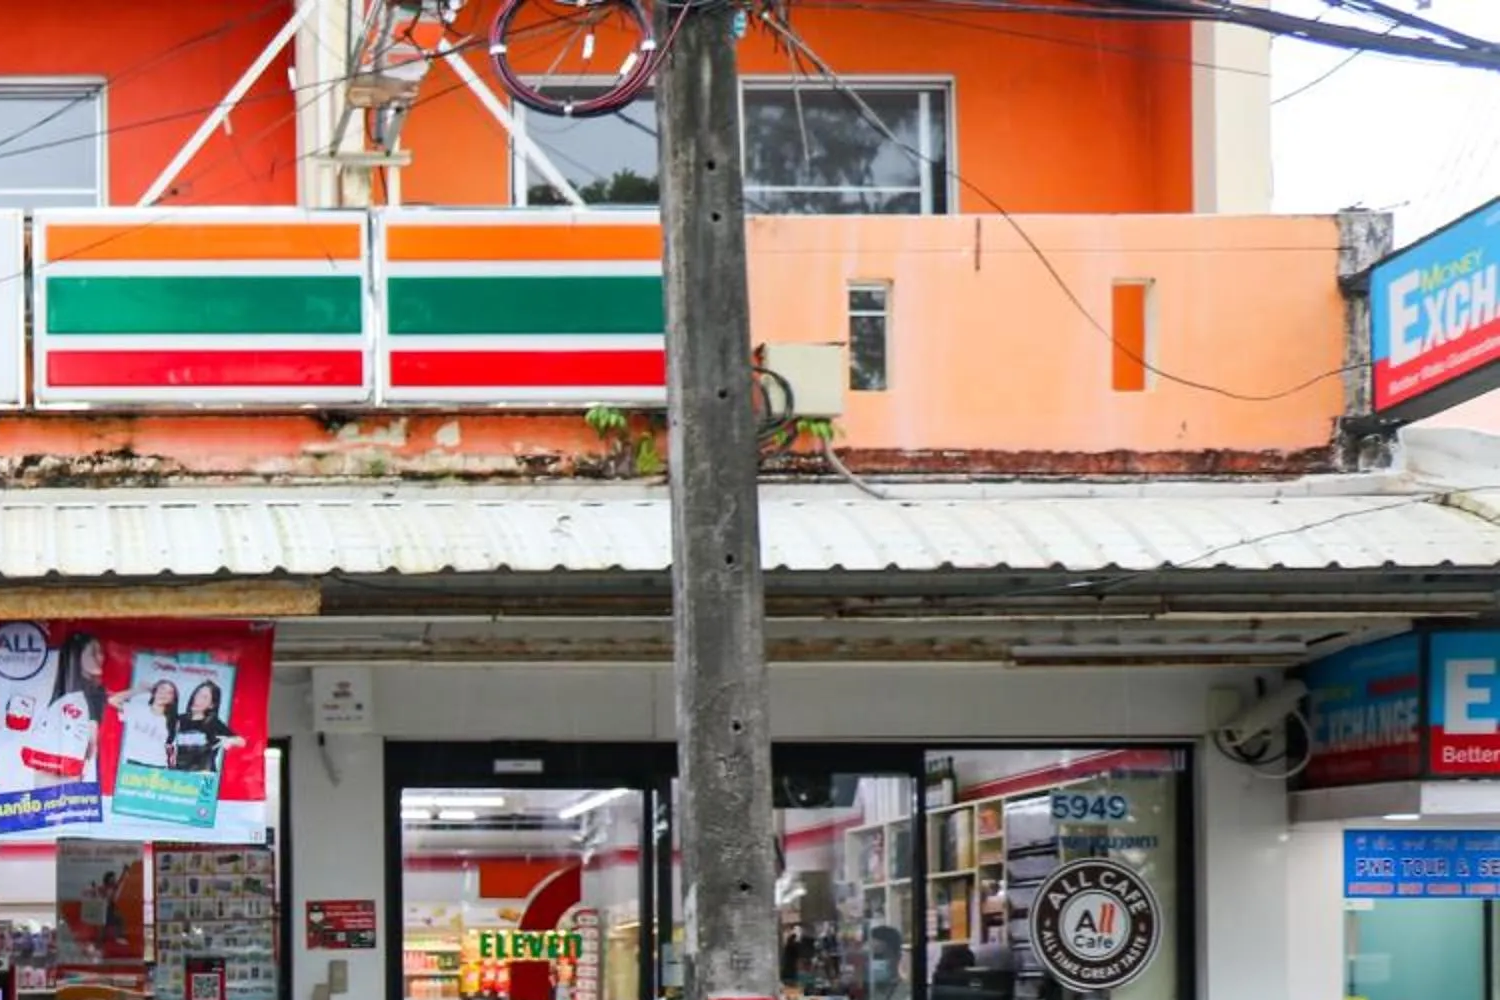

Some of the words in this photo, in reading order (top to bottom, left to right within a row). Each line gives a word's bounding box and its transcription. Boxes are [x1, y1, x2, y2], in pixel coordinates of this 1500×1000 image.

[1420, 248, 1485, 291] MONEY
[1388, 264, 1500, 368] EXCH
[1442, 746, 1500, 764] Better
[1051, 794, 1128, 820] 5949
[1048, 871, 1093, 911] ALL
[1080, 963, 1120, 980] GREAT
